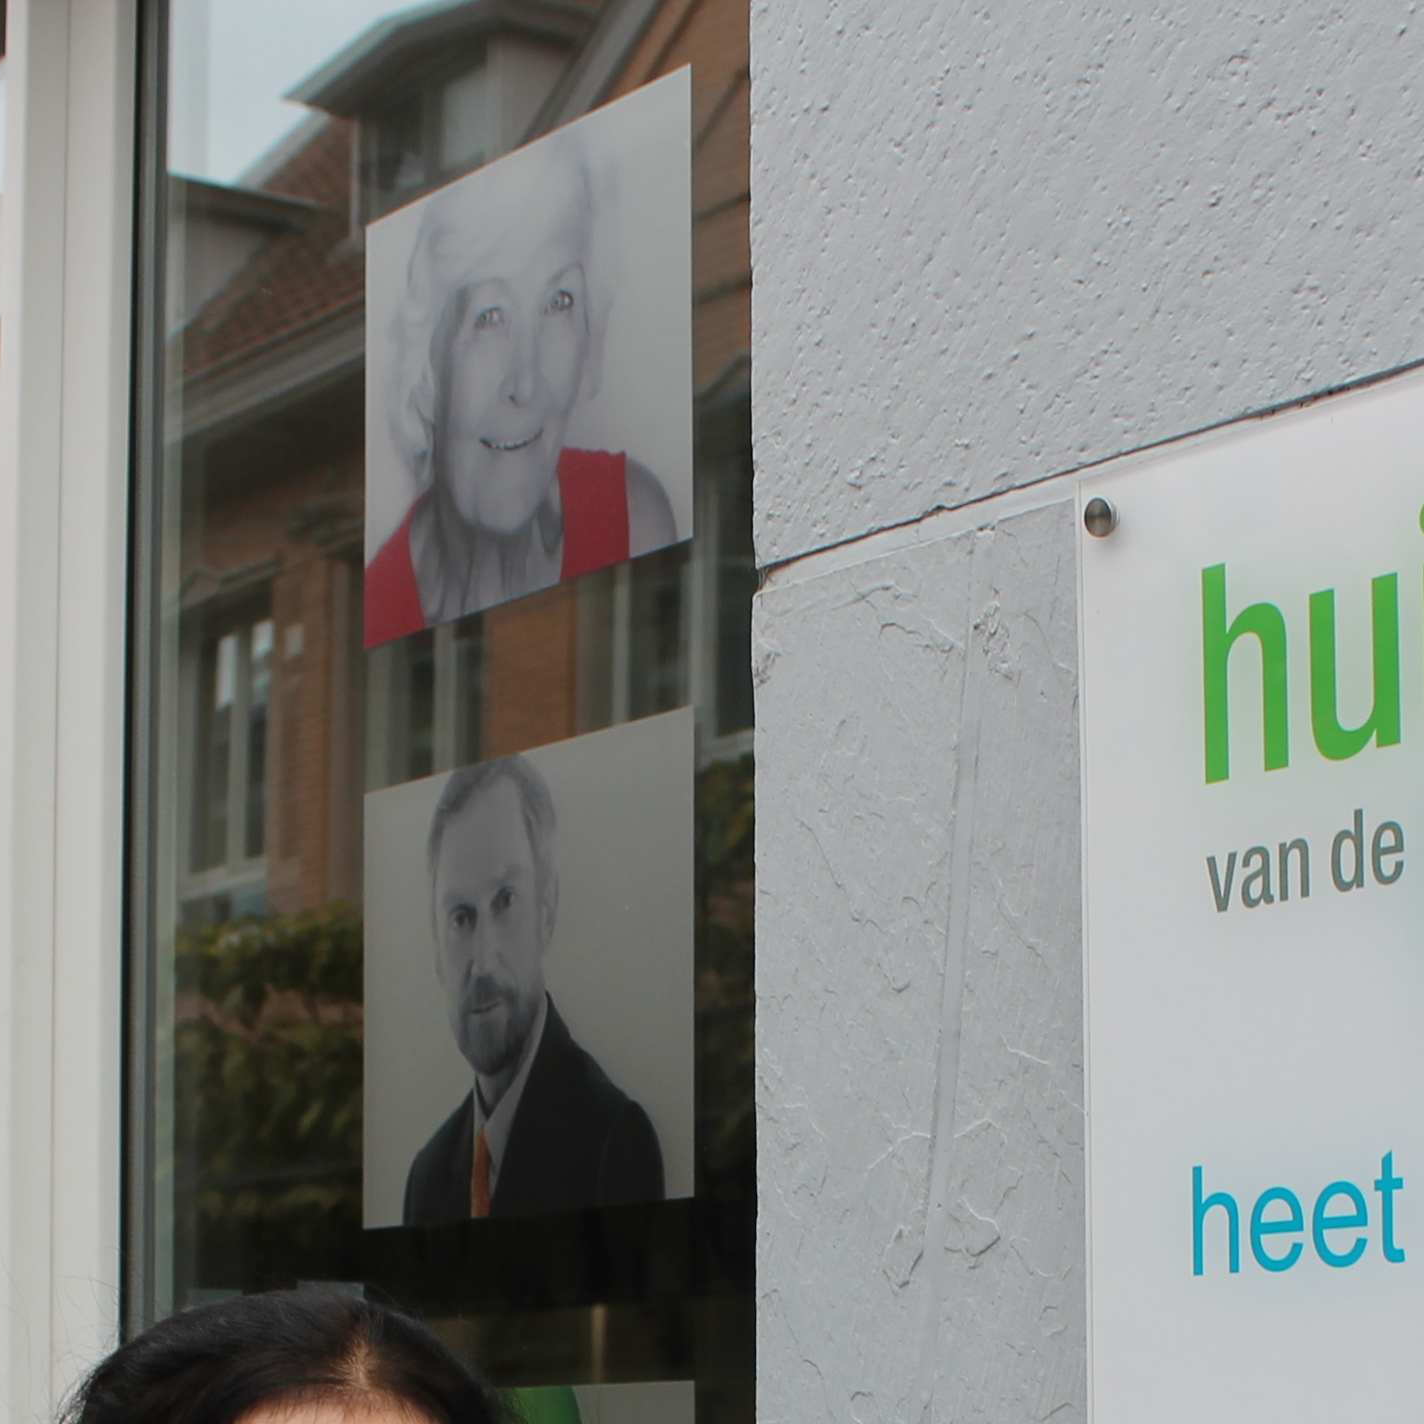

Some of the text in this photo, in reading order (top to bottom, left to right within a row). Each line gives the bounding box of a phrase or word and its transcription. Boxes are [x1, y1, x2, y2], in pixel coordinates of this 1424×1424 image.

[1206, 837, 1310, 914] van
[1330, 807, 1405, 893] de
[1192, 1150, 1406, 1276] heet
